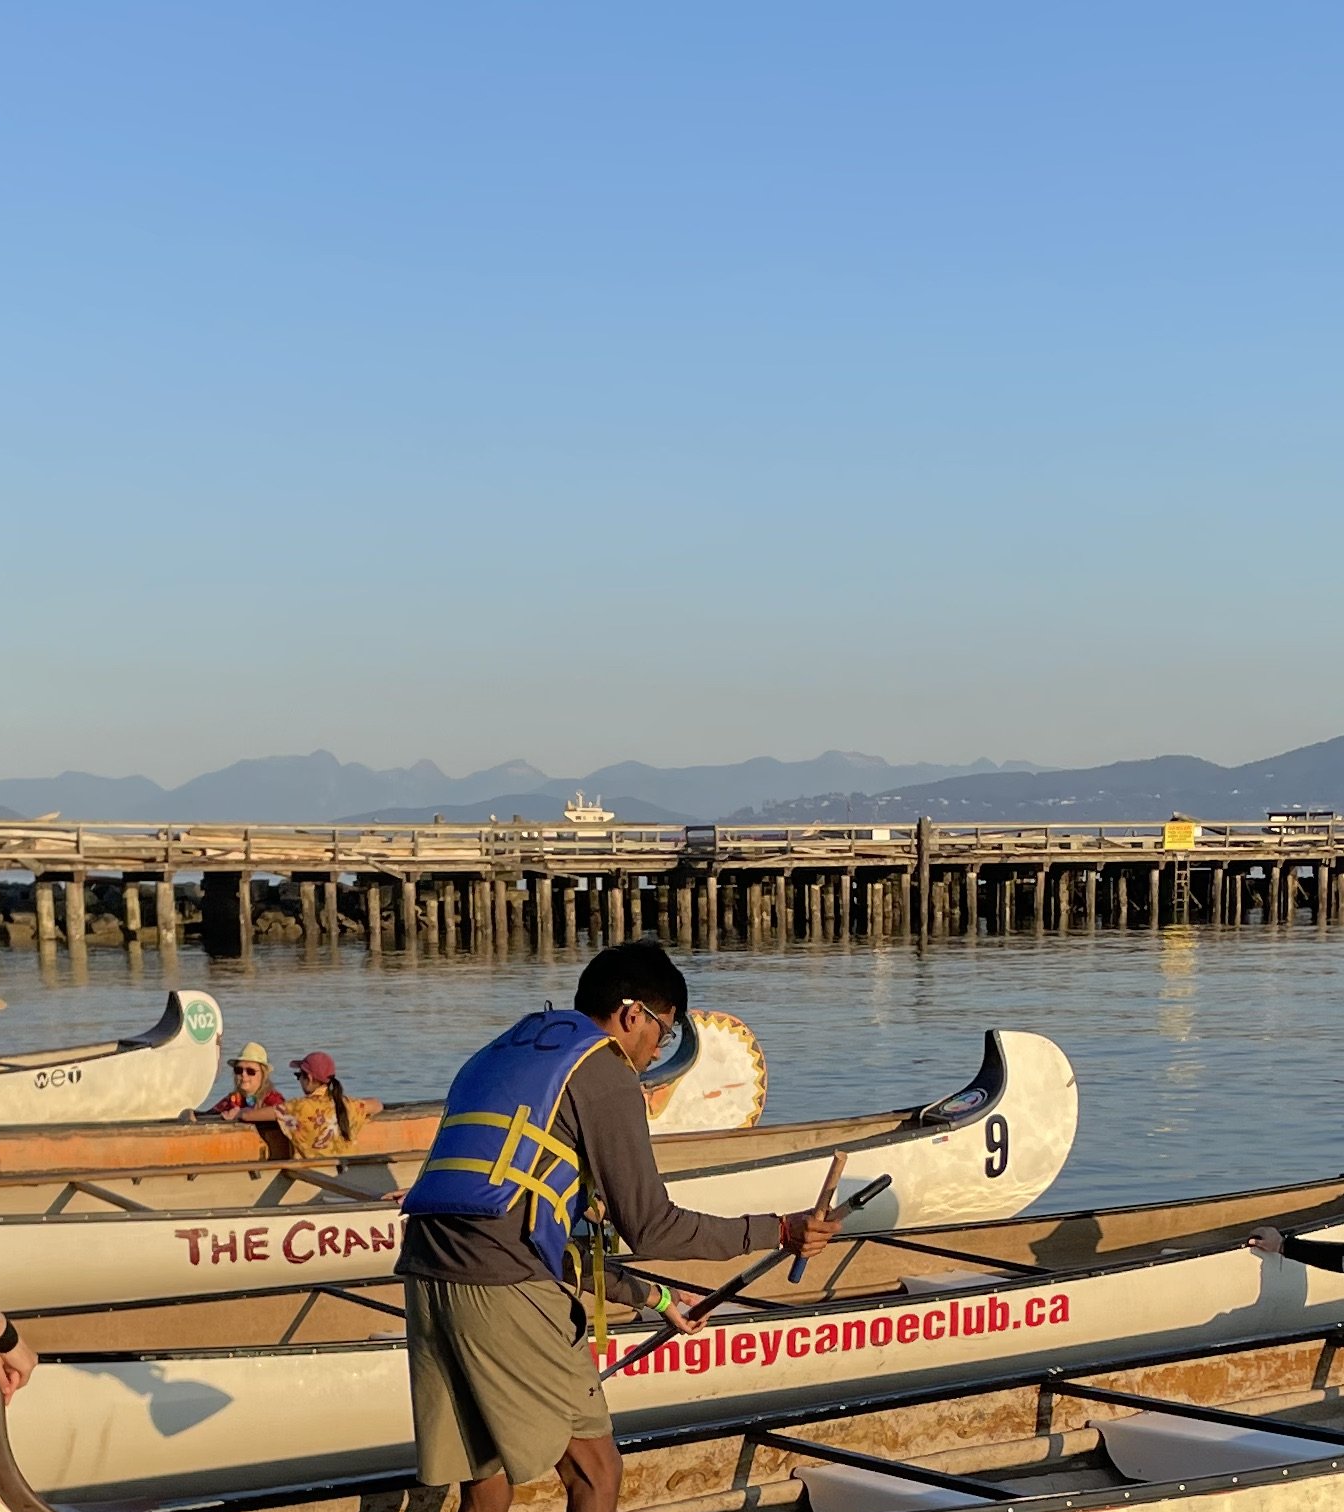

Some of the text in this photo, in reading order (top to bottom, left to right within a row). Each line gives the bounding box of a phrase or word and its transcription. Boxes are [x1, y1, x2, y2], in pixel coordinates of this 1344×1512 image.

[985, 1113, 1009, 1178] 9
[174, 1219, 406, 1266] THE CRAN
[589, 1293, 1071, 1378] langleycanoeclub.ca
